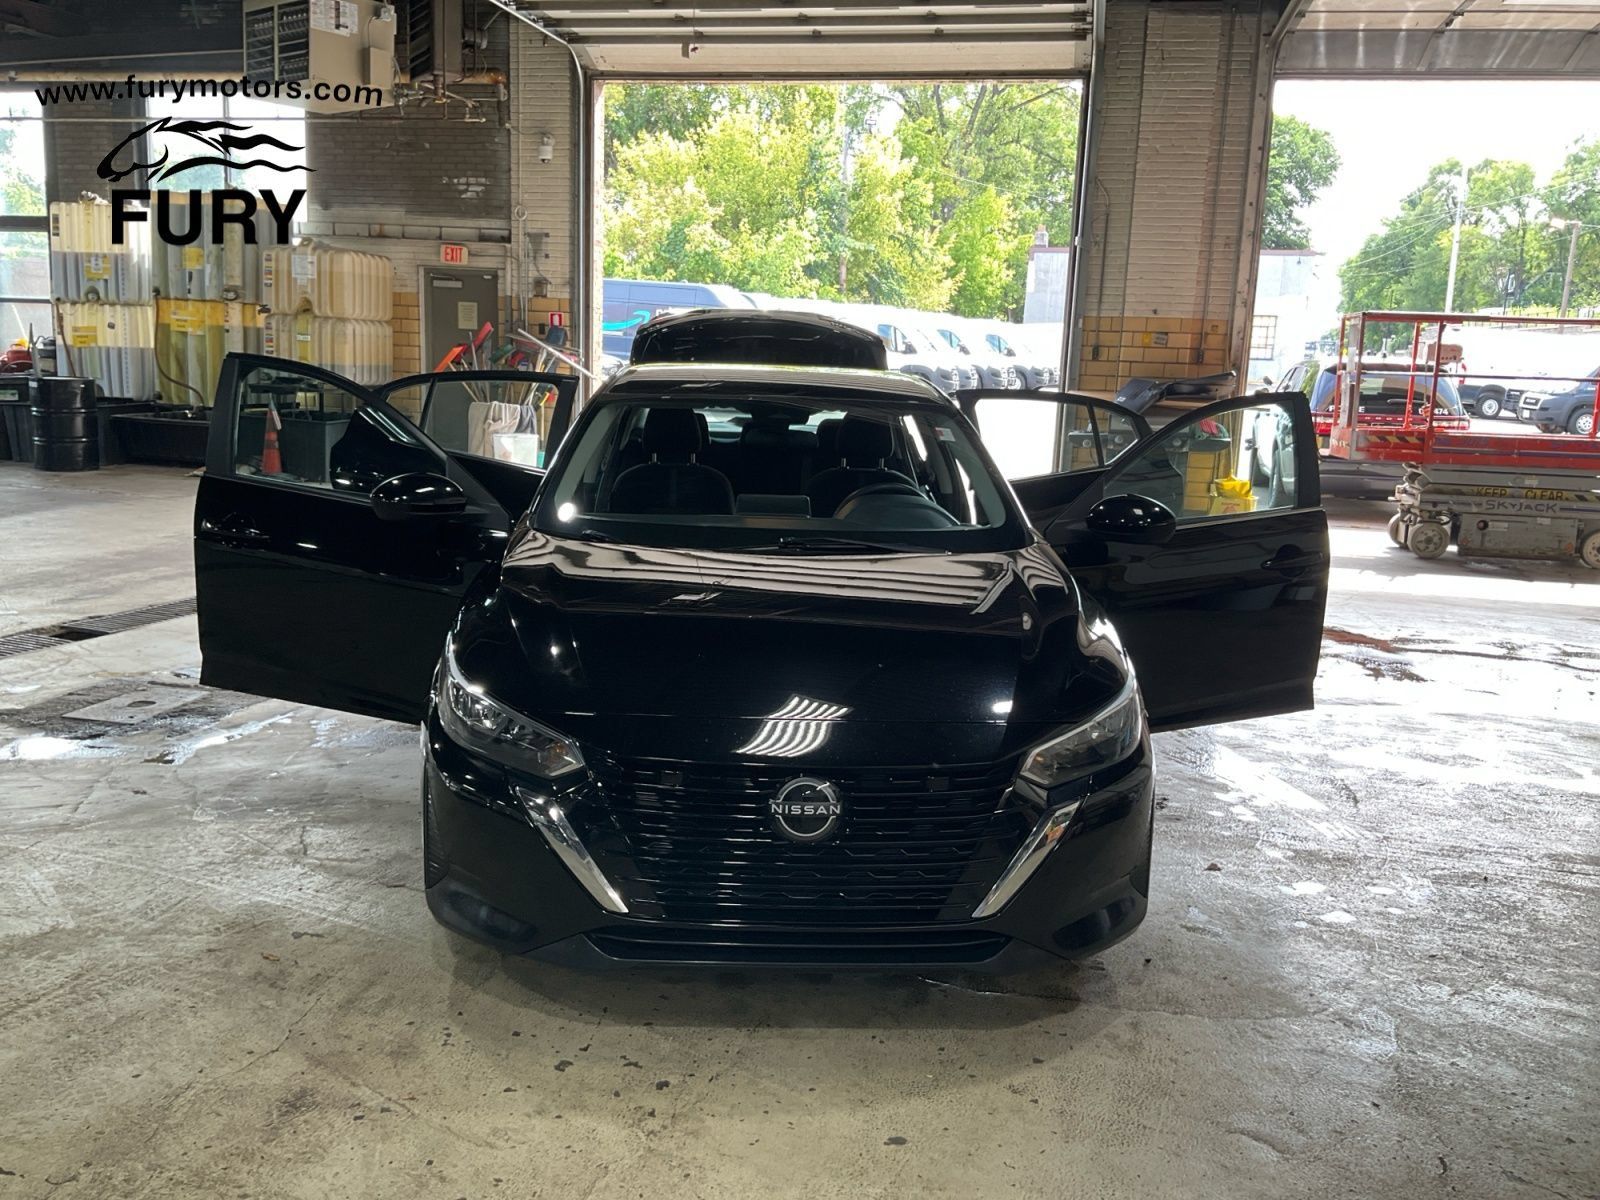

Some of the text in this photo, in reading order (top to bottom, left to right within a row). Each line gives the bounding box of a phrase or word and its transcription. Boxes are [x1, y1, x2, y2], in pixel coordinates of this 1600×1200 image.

[445, 246, 463, 263] EXIT
[1476, 487, 1564, 501] KEEP CLEAR
[1485, 500, 1558, 513] SKYJACK
[771, 804, 841, 815] NISSAN
